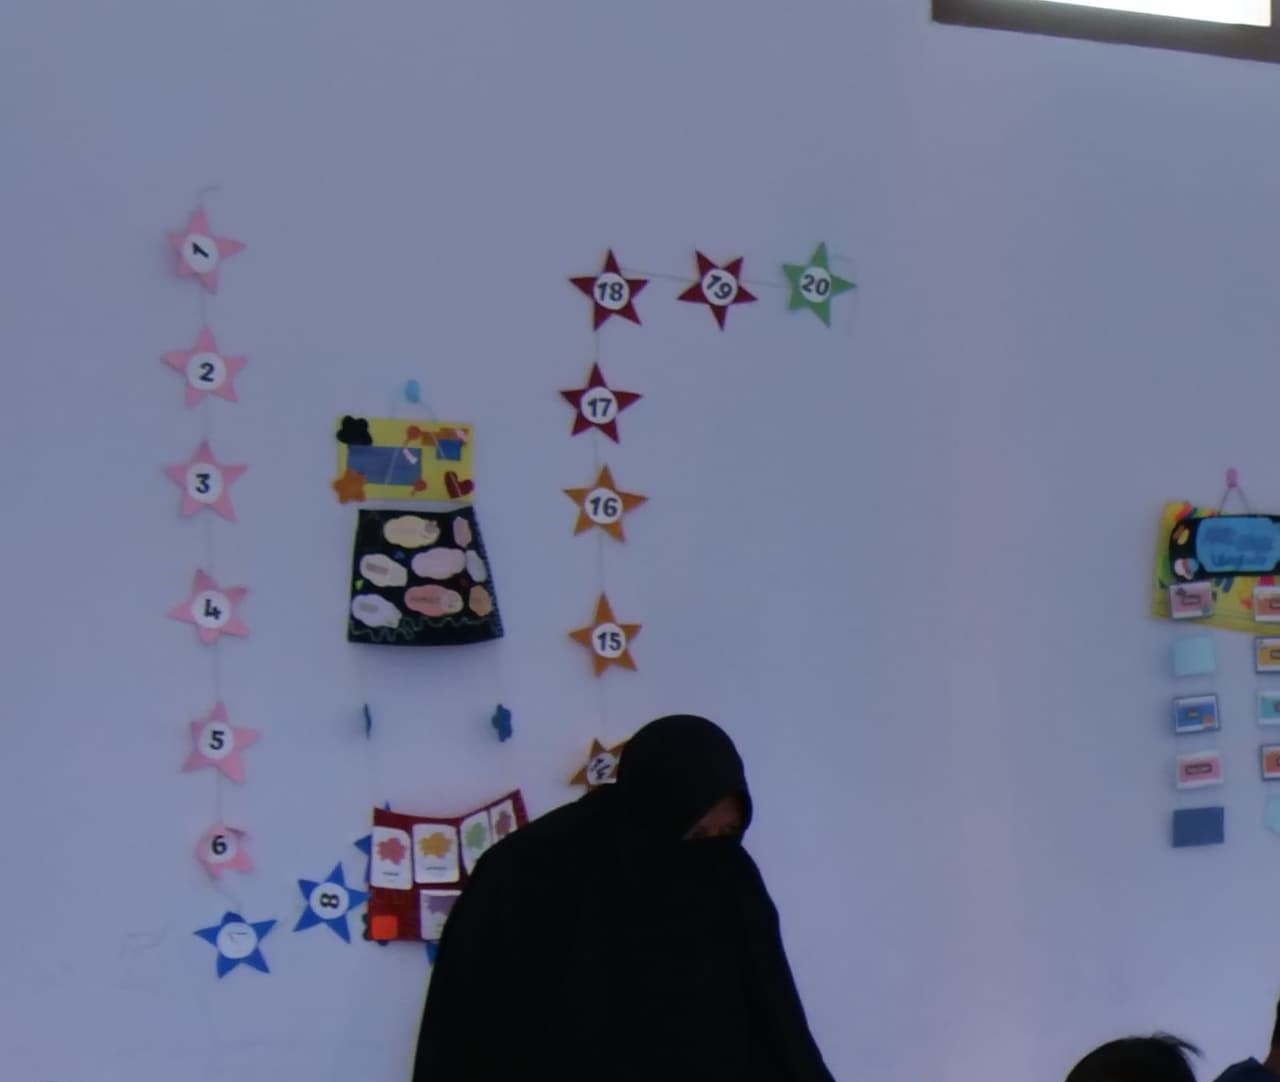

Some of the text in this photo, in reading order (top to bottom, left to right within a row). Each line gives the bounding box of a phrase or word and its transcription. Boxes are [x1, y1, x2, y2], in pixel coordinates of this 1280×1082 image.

[192, 242, 208, 258] 1
[597, 282, 623, 302] 18
[706, 275, 732, 299] 19
[802, 275, 829, 295] 20
[200, 362, 215, 382] 2
[588, 398, 613, 417] 17
[196, 474, 210, 493] 3
[590, 497, 617, 516] 16
[203, 599, 221, 619] 4
[598, 632, 621, 651] 15
[210, 730, 224, 750] 5
[211, 835, 226, 854] 6
[320, 892, 340, 908] 8
